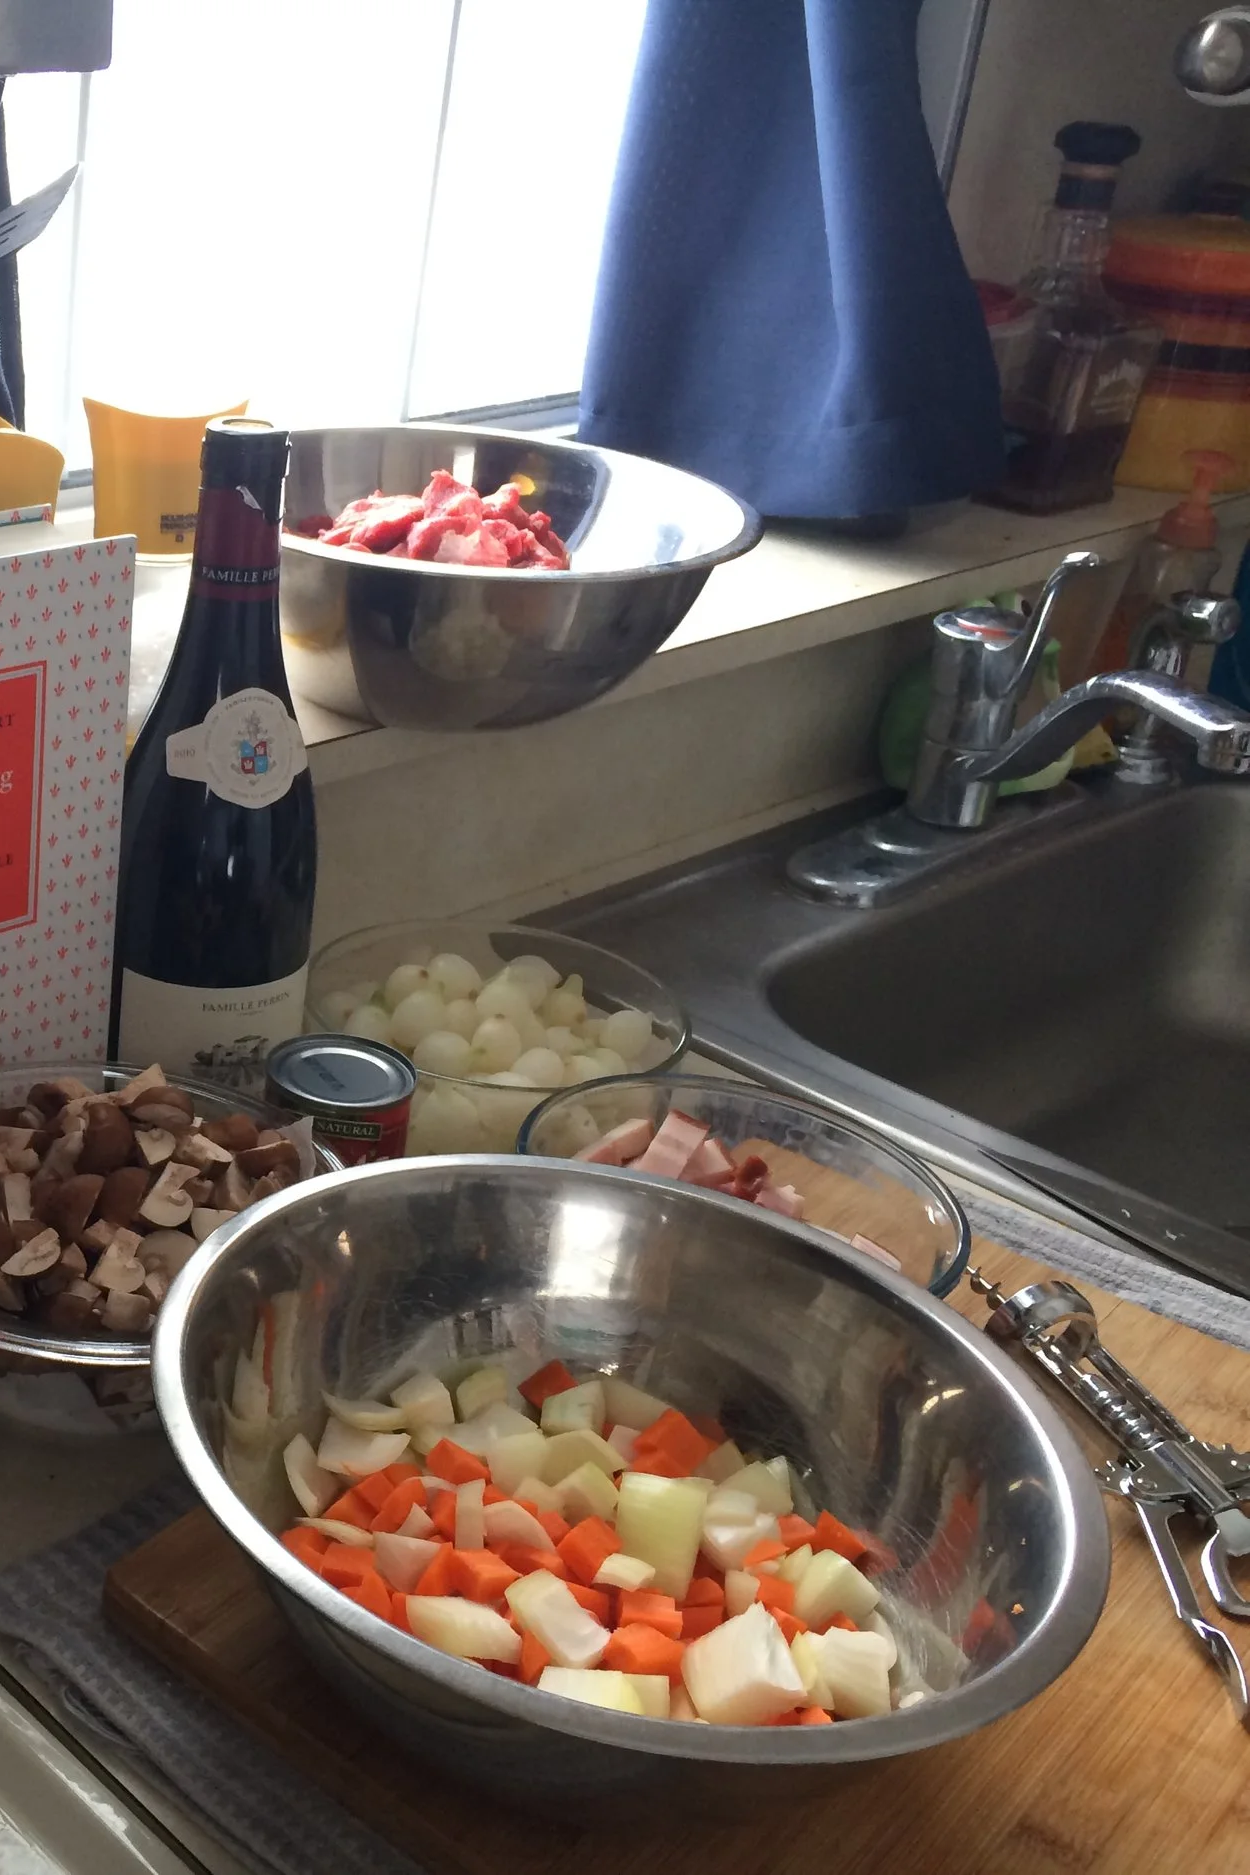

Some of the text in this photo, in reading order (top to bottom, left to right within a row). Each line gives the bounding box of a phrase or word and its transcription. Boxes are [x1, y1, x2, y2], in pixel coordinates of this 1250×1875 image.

[202, 566, 258, 583] FAMILLE
[202, 992, 290, 1012] FAMILLE PERRIN
[317, 1120, 375, 1136] NATURAL
